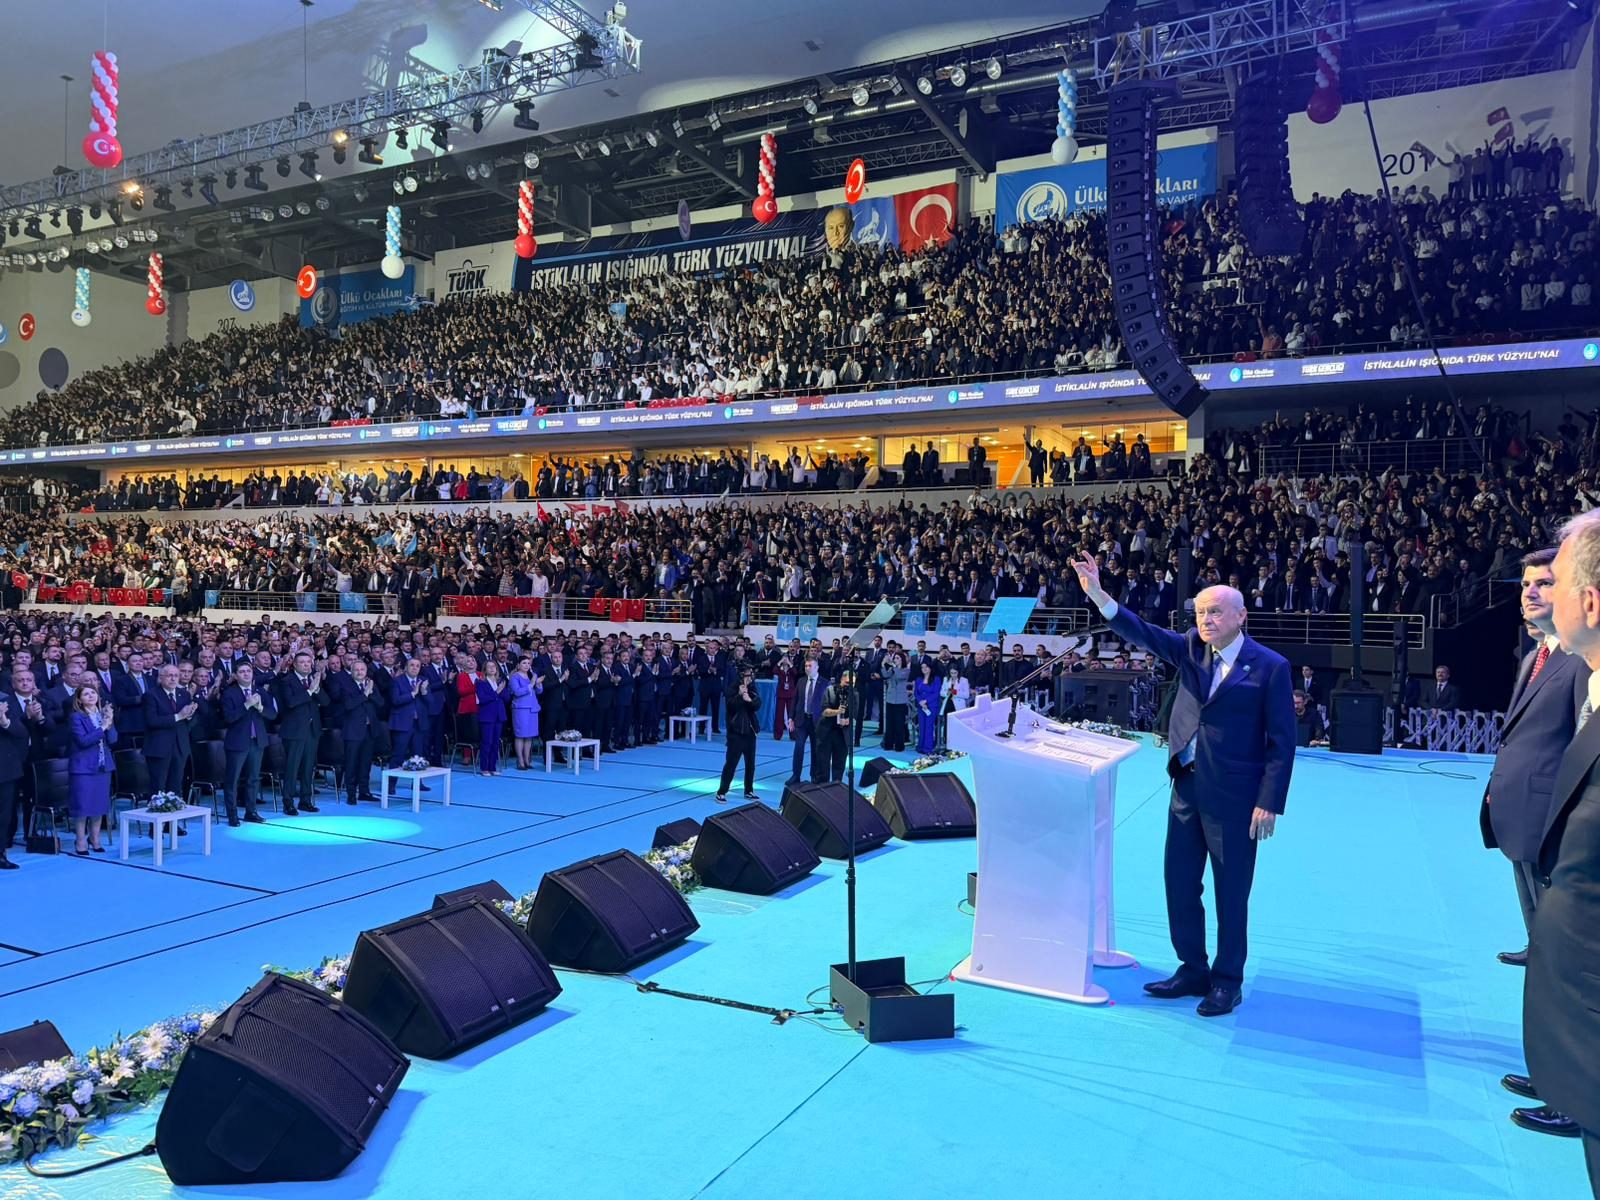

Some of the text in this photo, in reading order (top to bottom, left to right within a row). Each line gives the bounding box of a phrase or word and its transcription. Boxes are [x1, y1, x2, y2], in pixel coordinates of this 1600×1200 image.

[673, 247, 712, 273] TÜRK
[449, 268, 486, 292] TÜRK
[1364, 350, 1560, 371] İSTİKLALİN IŞIĞNDA TÜRK YÜZYILI'NA!
[1055, 381, 1097, 393] İSTİKLALİN
[1099, 378, 1135, 390] IŞIĞINDA
[875, 398, 893, 406] TÜRK
